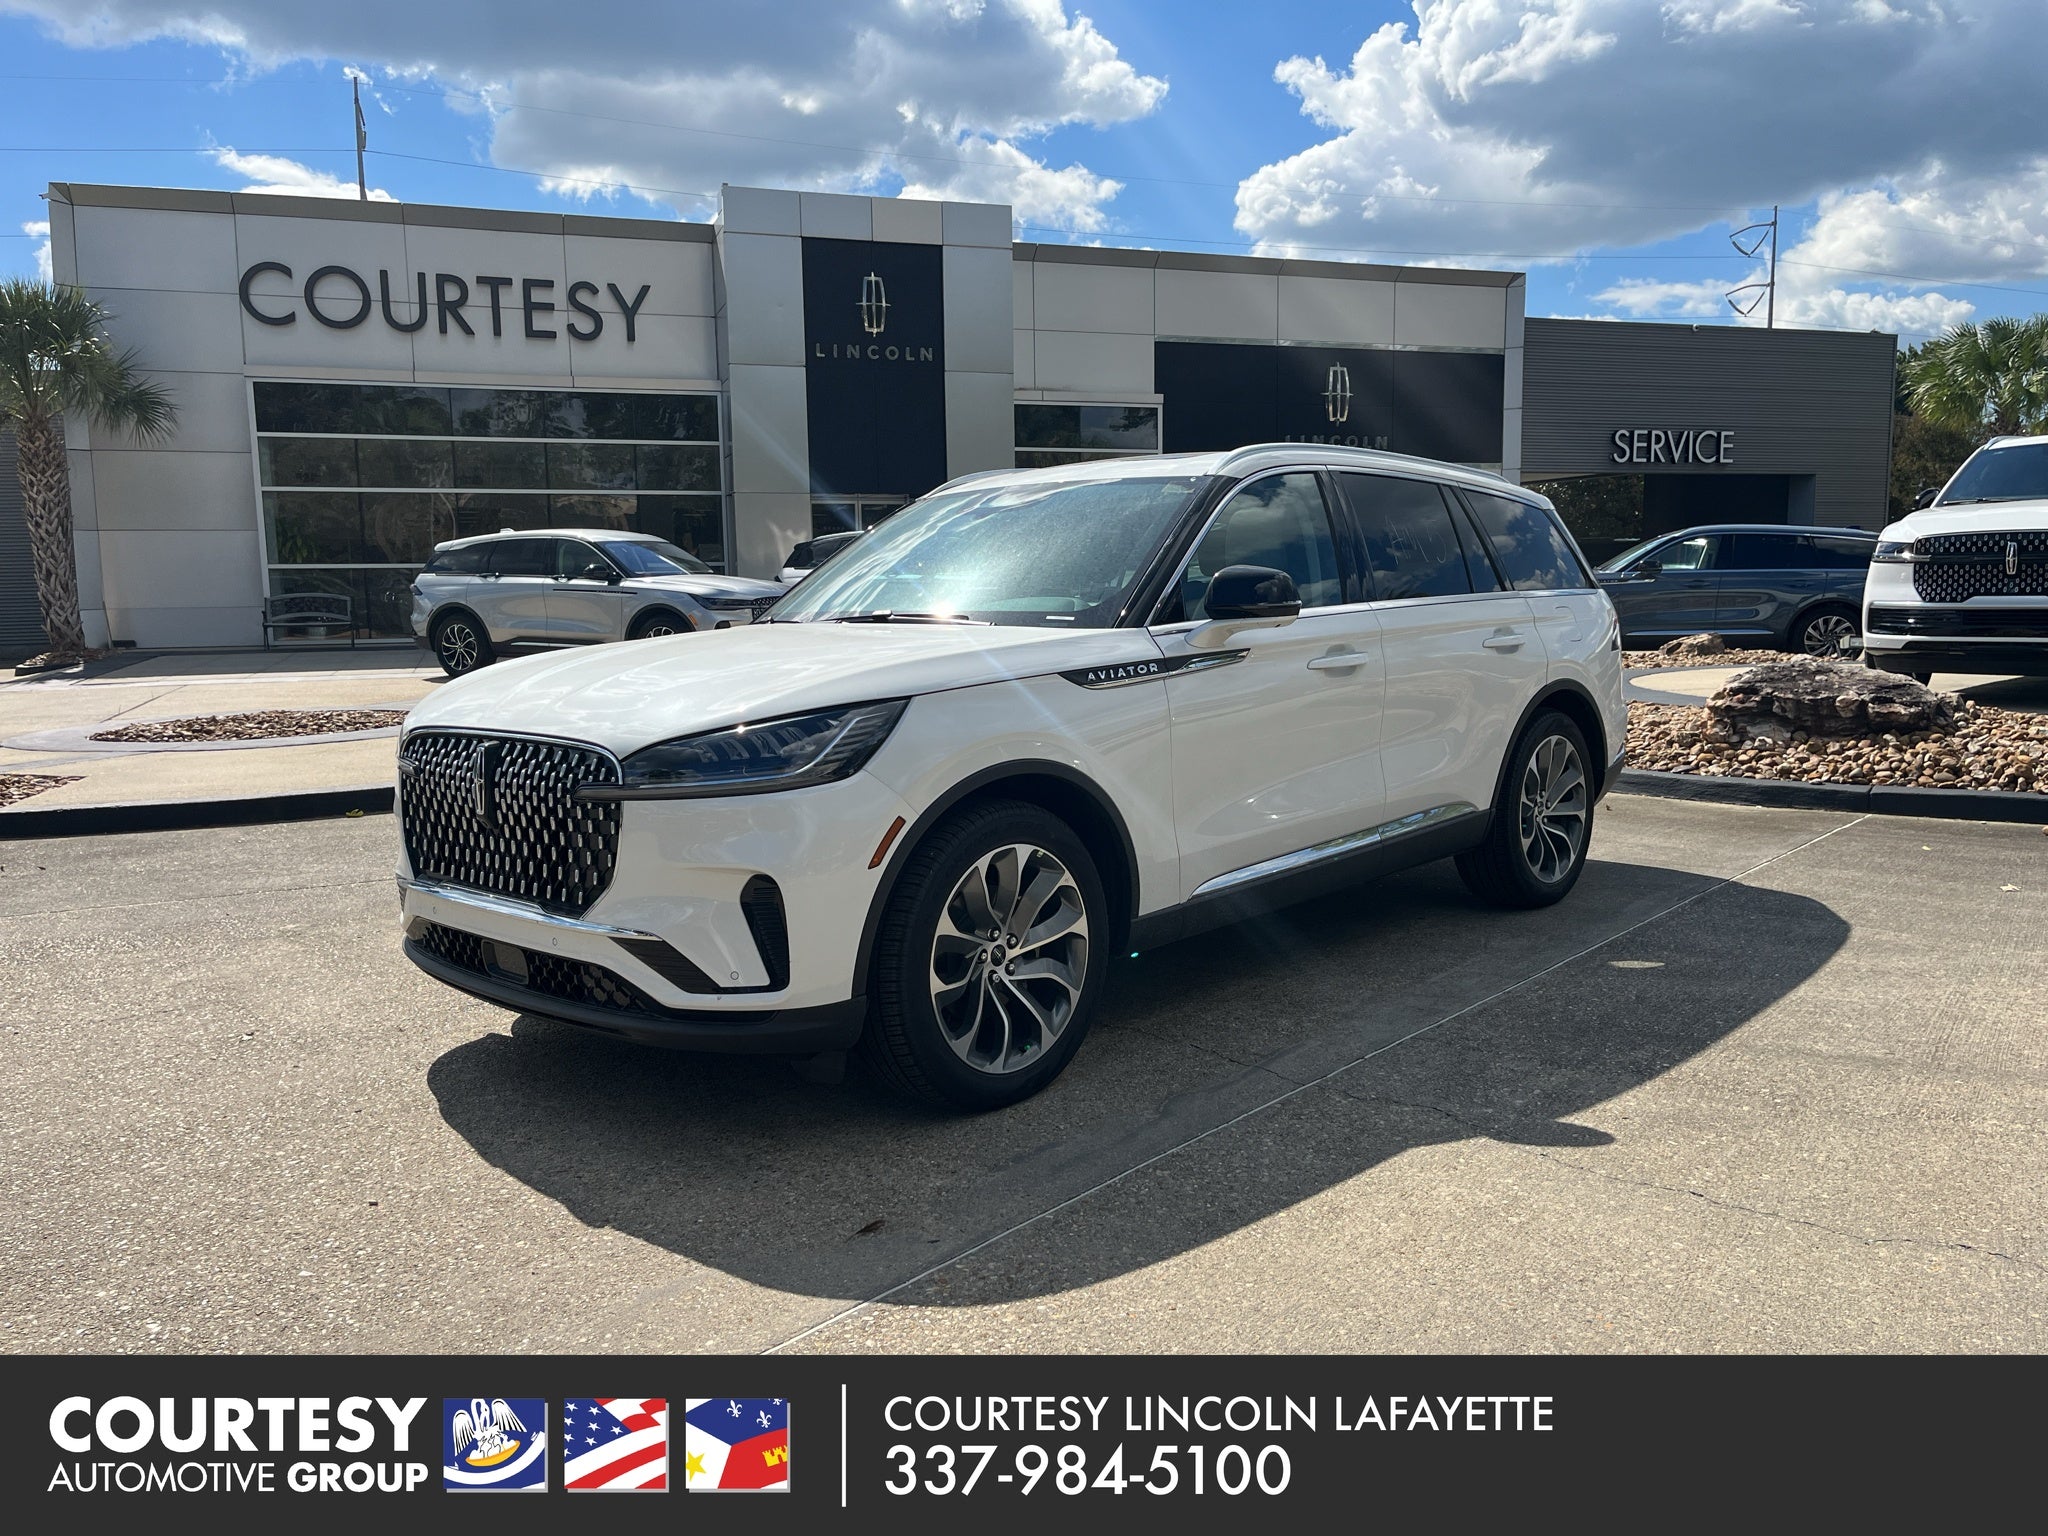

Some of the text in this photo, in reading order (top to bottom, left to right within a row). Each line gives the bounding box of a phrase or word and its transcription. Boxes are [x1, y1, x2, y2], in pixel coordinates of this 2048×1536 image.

[239, 261, 651, 343] COURTESY
[815, 342, 934, 362] LINCOLN
[1612, 428, 1736, 464] SERVICE
[1087, 662, 1160, 682] AVIATOR
